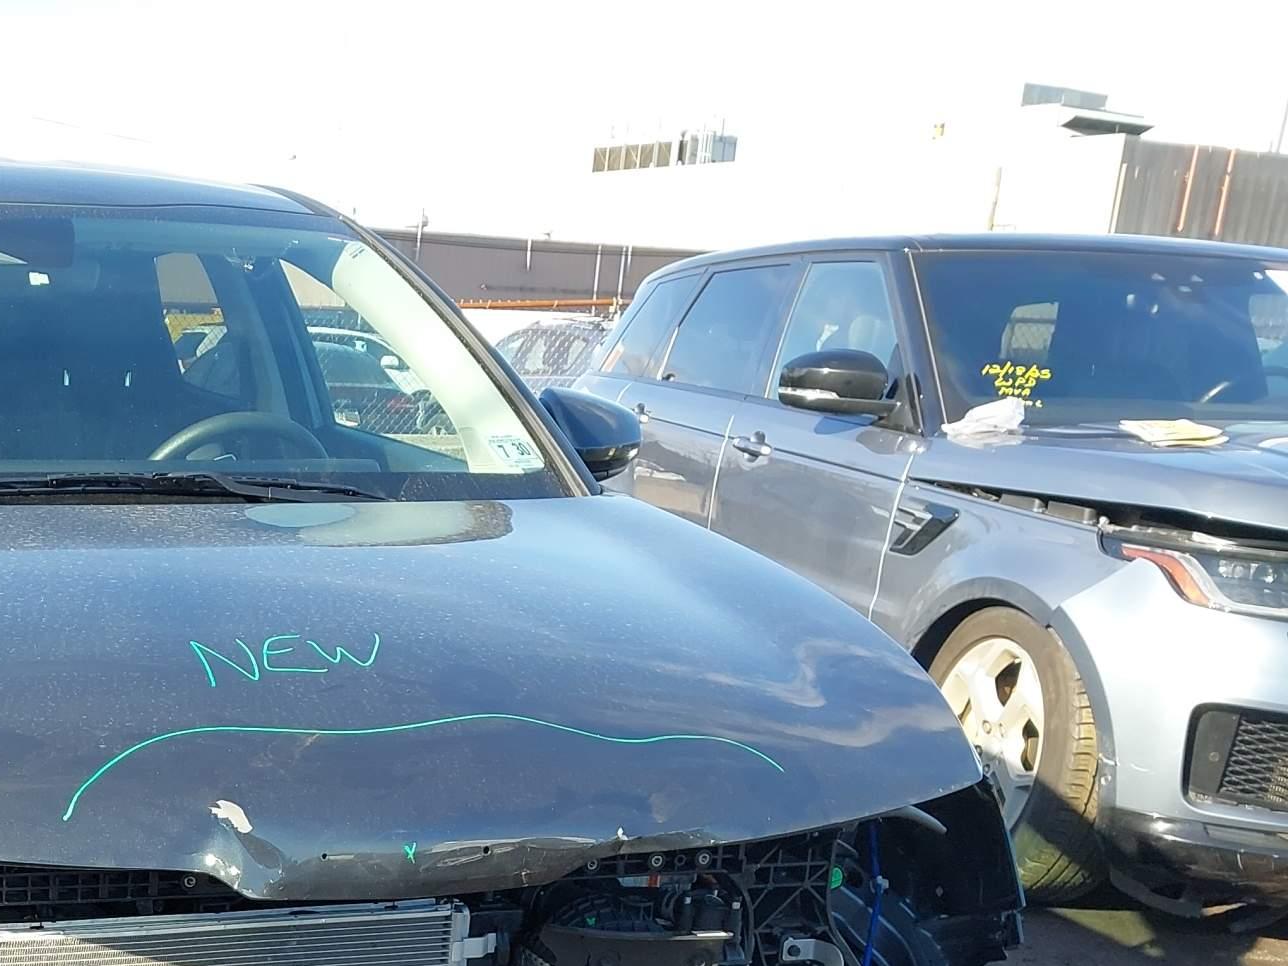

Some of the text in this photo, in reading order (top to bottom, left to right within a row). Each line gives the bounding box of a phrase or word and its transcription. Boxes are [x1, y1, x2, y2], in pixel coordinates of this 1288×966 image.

[497, 442, 531, 458] 7 30
[190, 633, 381, 687] NEW
